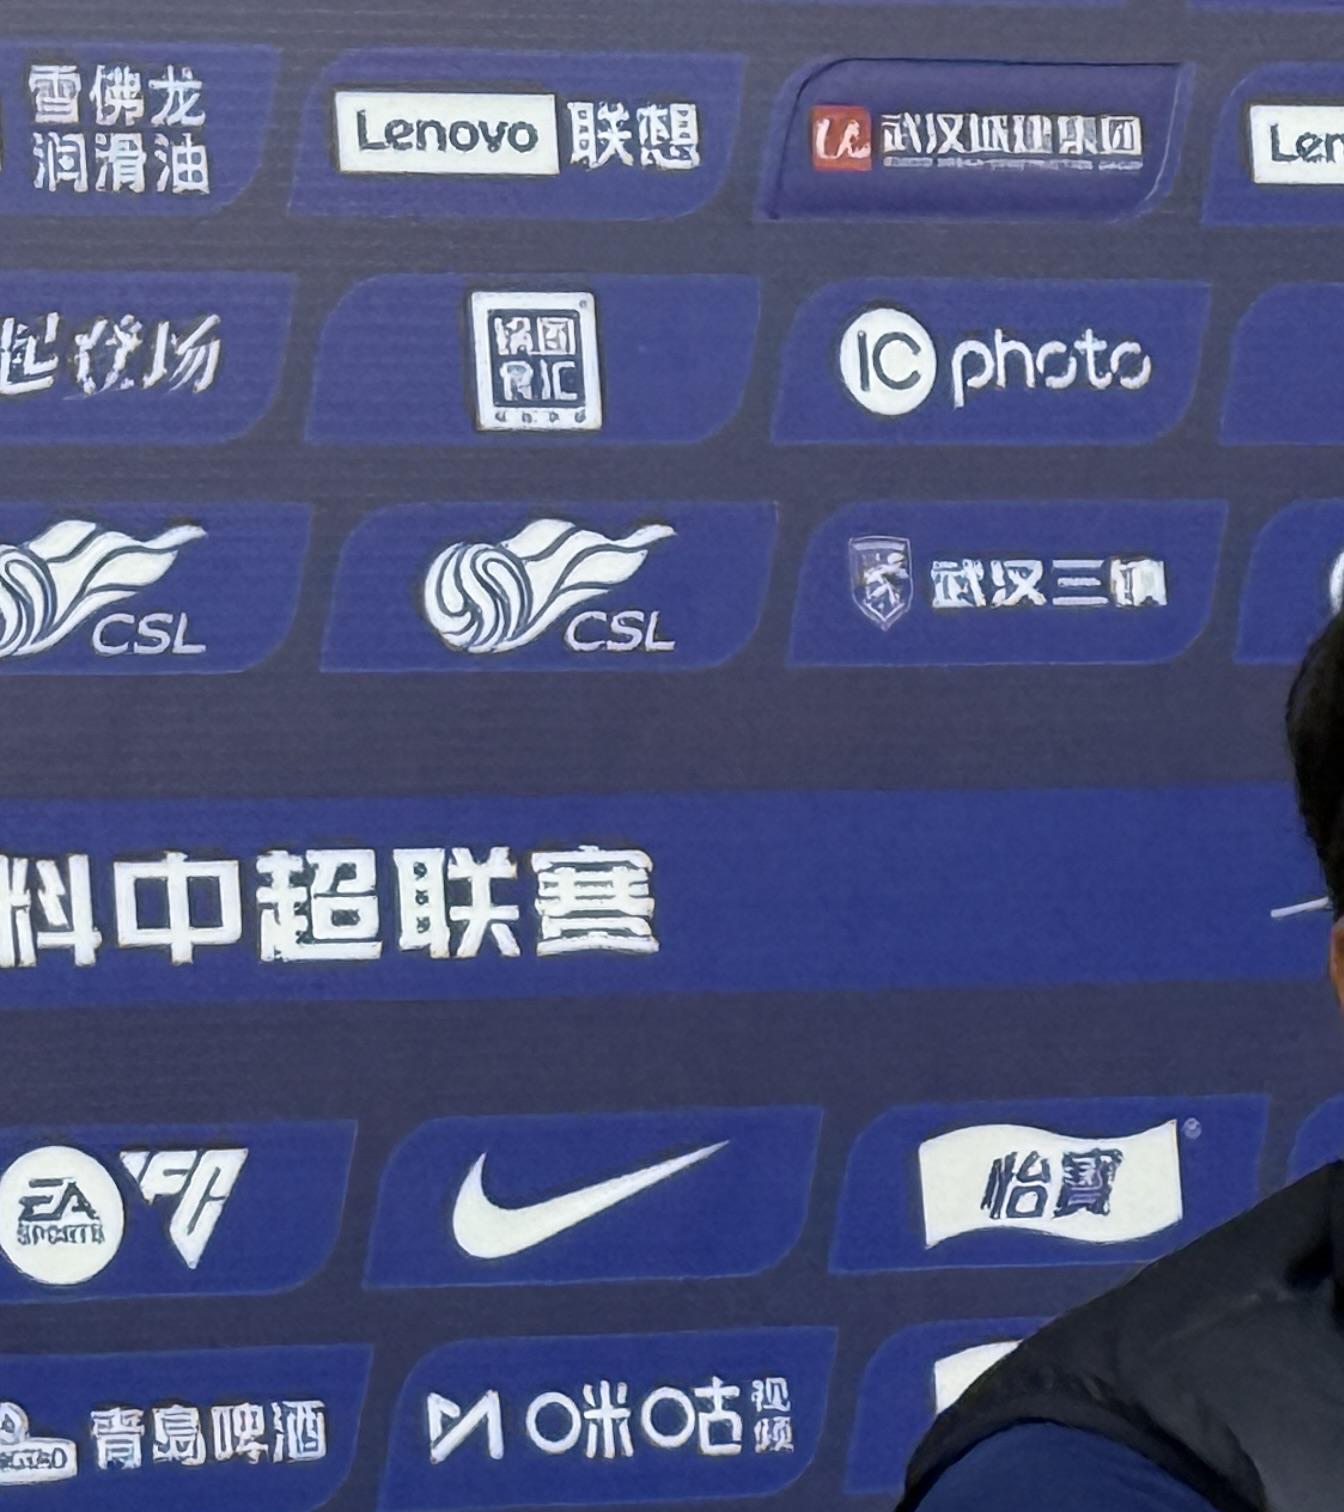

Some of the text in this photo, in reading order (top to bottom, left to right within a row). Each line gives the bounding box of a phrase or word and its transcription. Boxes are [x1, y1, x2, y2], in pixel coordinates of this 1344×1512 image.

[29, 65, 205, 125] 雪佛龙
[33, 132, 209, 193] 润滑油
[357, 102, 699, 169] Lenovo 联想
[857, 328, 1151, 407] IC photo
[92, 611, 207, 655] CSL
[564, 610, 676, 653] CSL
[0, 846, 658, 967] 料中超联赛
[18, 1178, 100, 1222] EA
[980, 1148, 1123, 1220] 怡寶
[91, 1401, 325, 1469] 青岛啤酒
[526, 1376, 793, 1458] 咪咕 视频
